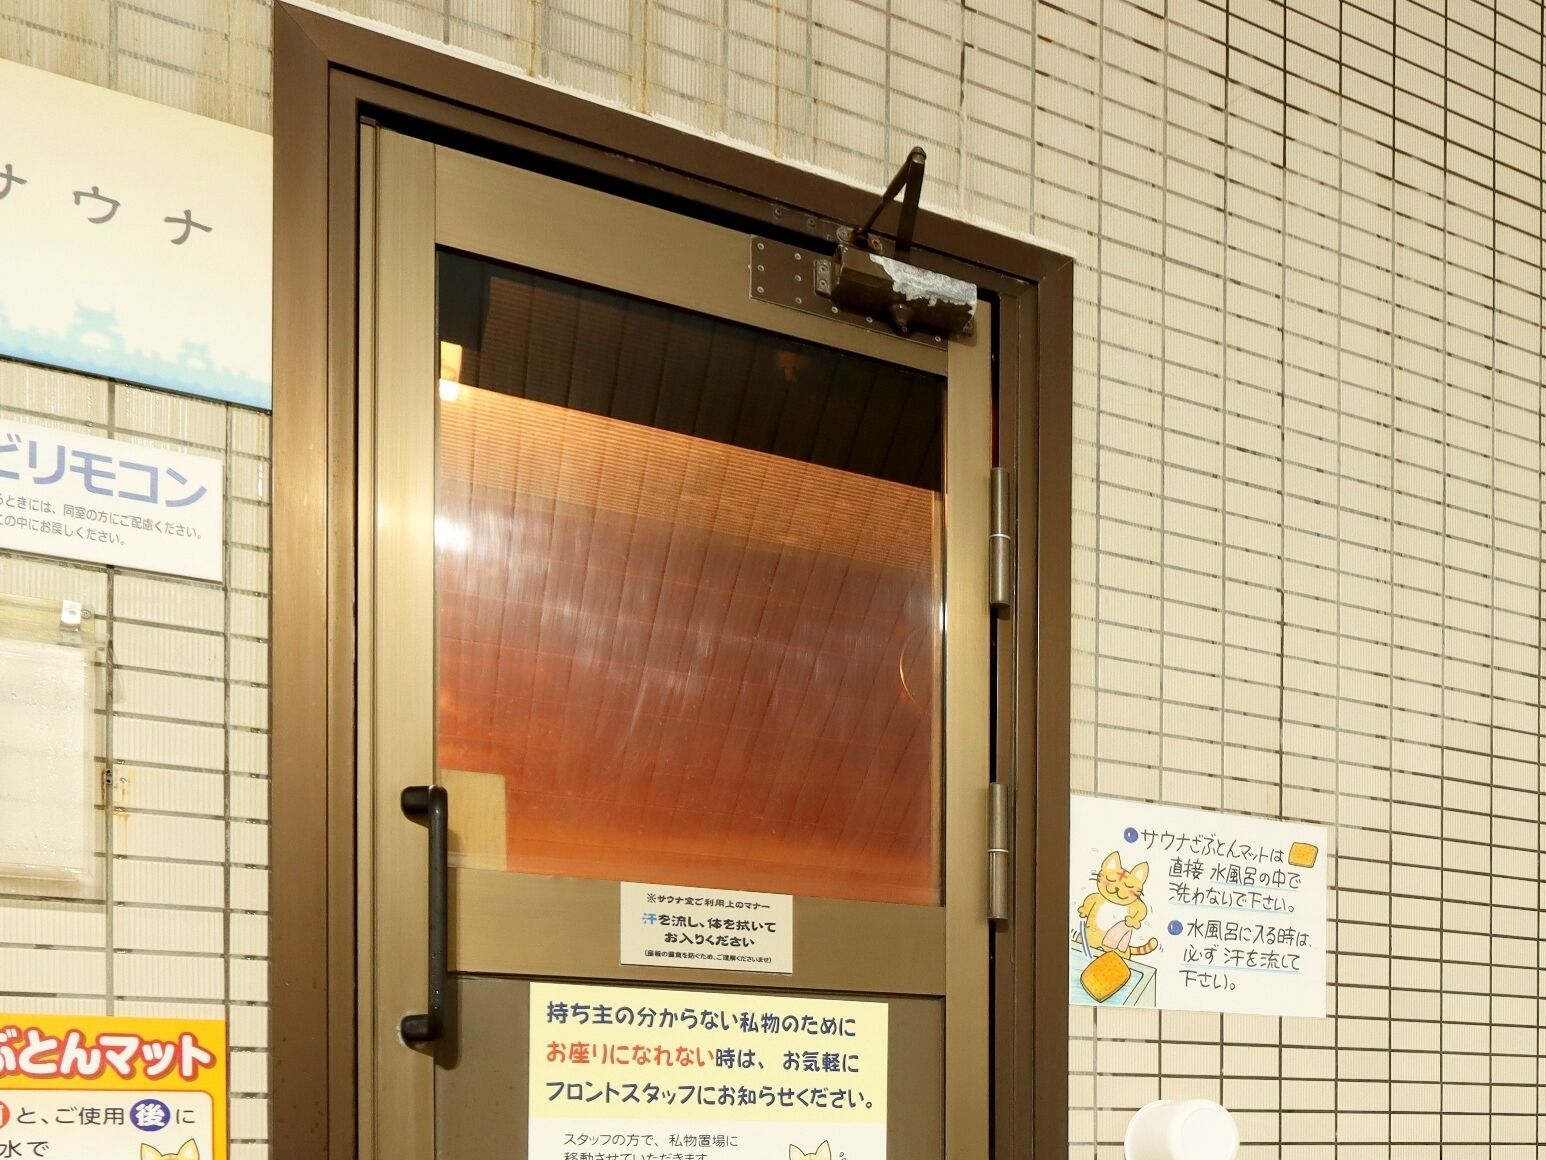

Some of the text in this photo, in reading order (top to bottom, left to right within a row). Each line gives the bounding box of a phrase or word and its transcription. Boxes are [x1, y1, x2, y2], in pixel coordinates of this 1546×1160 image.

[0, 513, 125, 546] の中にお戻しください。
[1141, 829, 1284, 864] サウナざぶとんマットは
[1168, 882, 1295, 913] 洗わないで下さい。
[642, 912, 776, 933] 汗を流し、体を拭いて
[664, 931, 755, 948] お入りください
[1179, 968, 1236, 991] 下さい。
[547, 1001, 856, 1037] 持ち主の分からない私物のために
[546, 1081, 873, 1109] フロントスタッフにお知らせください。
[0, 1102, 195, 1128] と、ご使用後に
